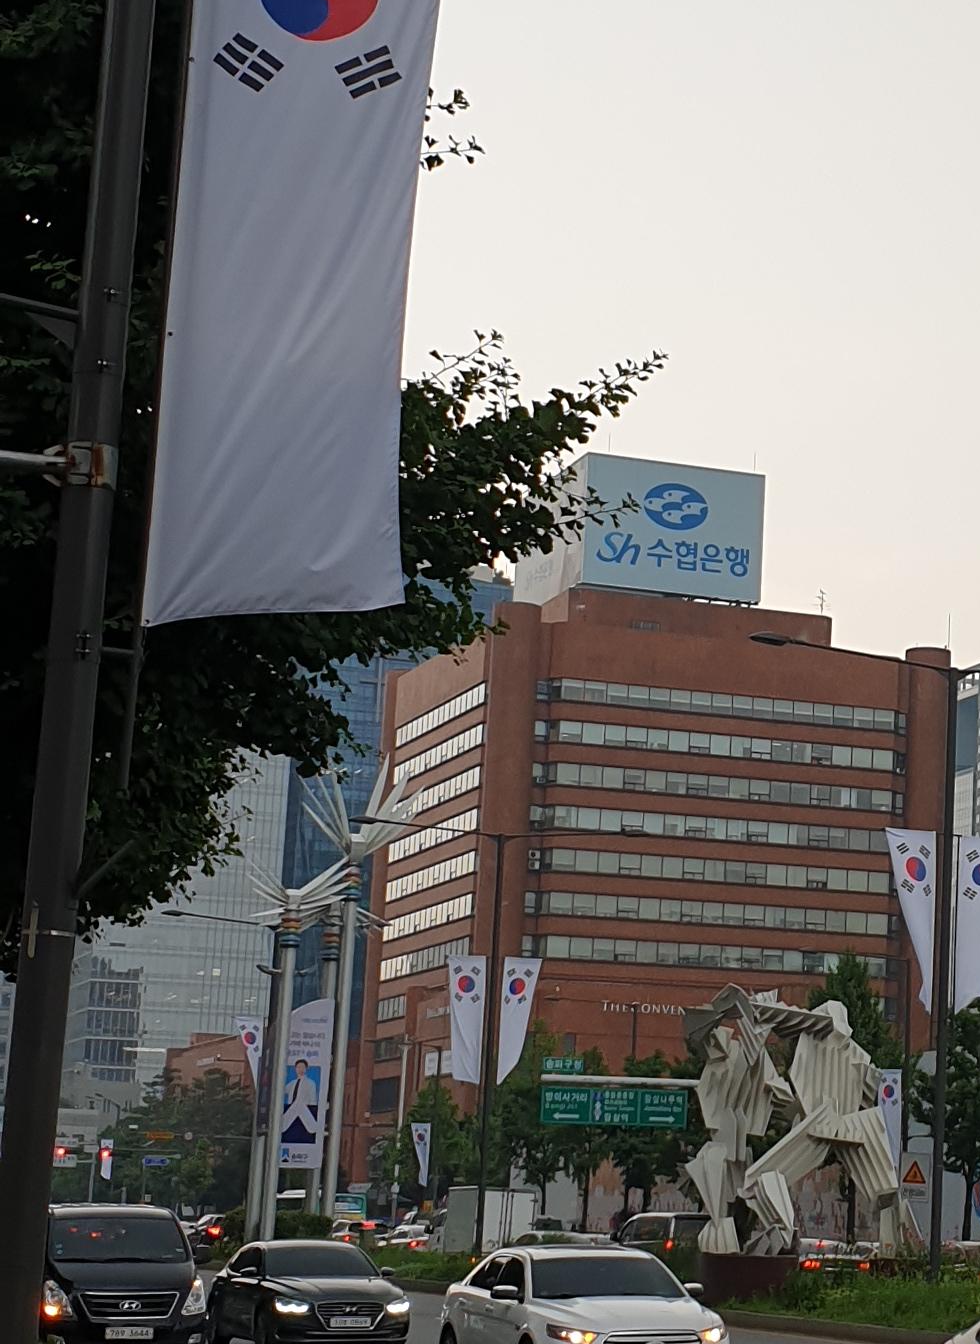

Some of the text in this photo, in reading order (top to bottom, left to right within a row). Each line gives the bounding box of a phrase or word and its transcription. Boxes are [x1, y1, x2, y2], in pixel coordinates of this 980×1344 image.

[596, 531, 750, 578] Sh 수협은행
[601, 1000, 629, 1013] THE
